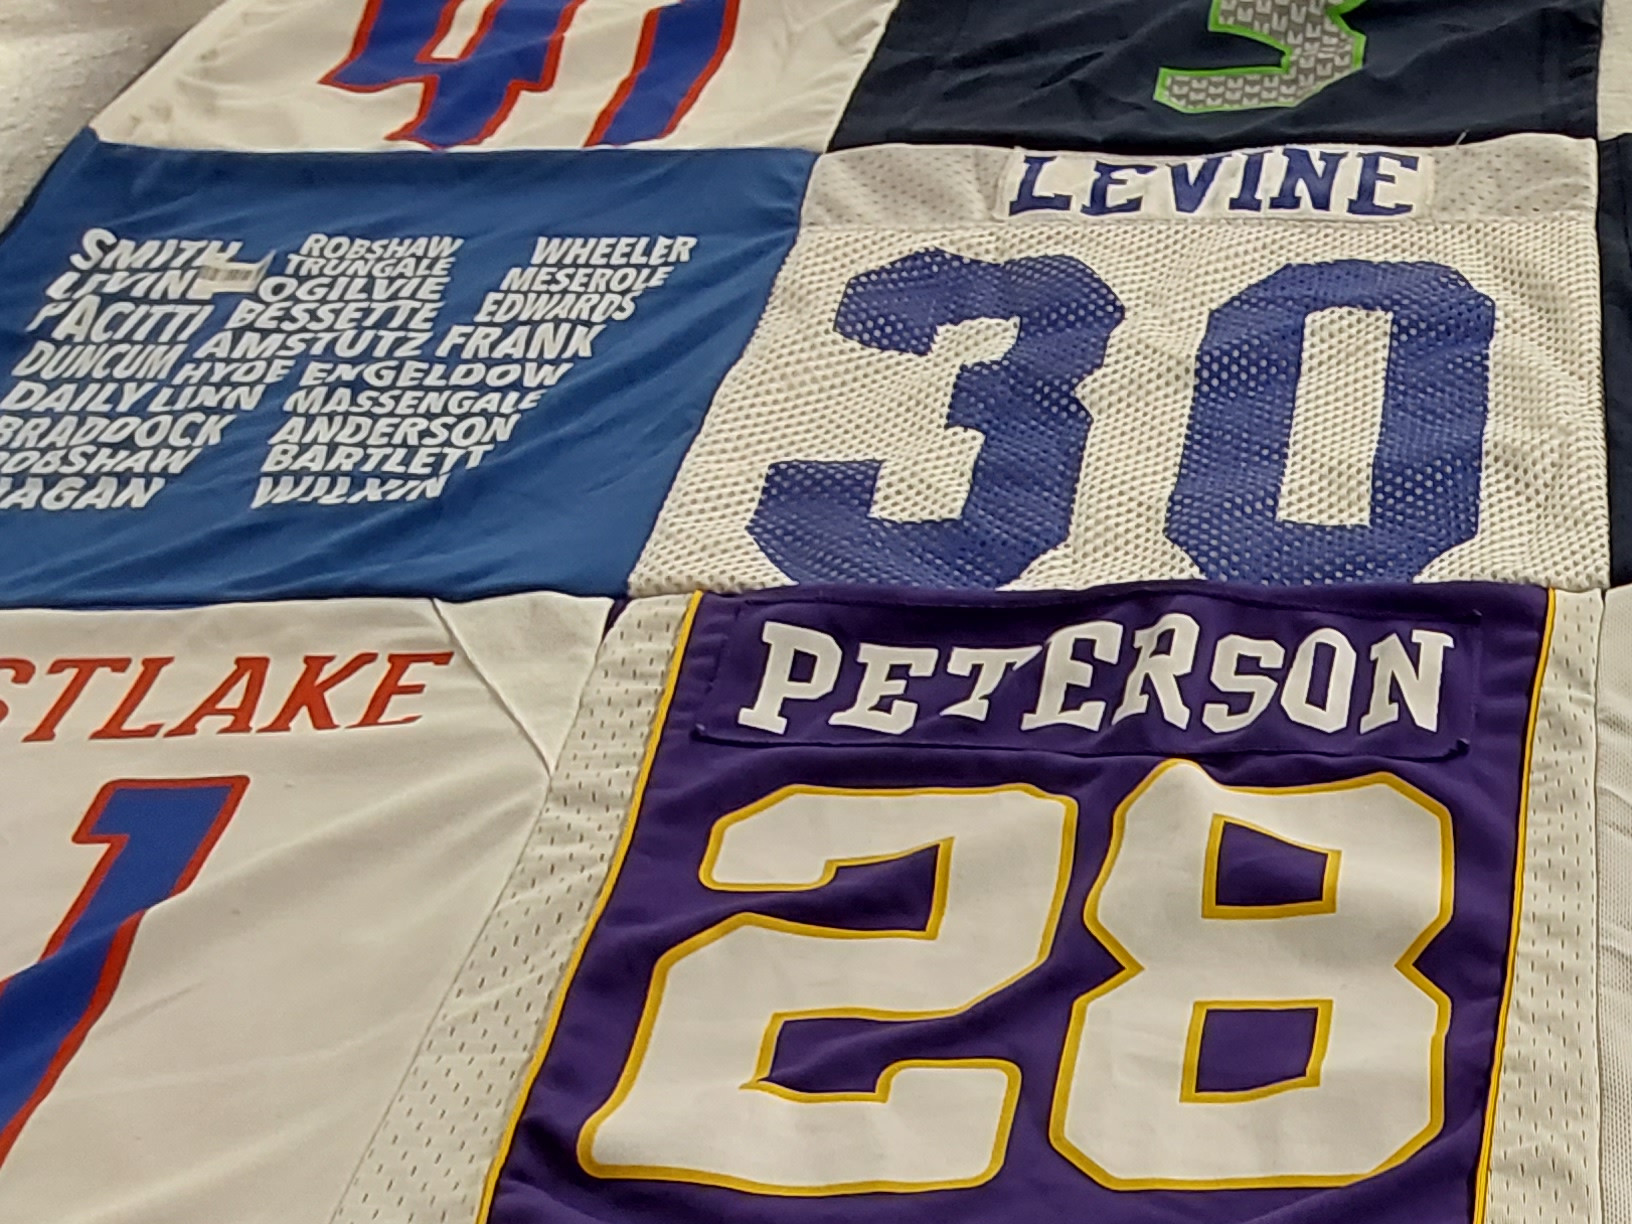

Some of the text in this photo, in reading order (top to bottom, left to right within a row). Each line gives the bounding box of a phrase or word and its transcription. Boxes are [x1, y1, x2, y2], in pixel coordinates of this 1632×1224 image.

[319, 0, 740, 149] 41
[1008, 148, 1423, 217] LEVINE
[70, 228, 243, 271] SMITH
[300, 233, 464, 258] ROBSHAW
[531, 236, 697, 265] WHEELER
[285, 253, 456, 277] TRUNGALE
[500, 266, 674, 292] MESEROLE
[259, 275, 450, 302] OGILVIE
[225, 300, 445, 330] BESSETTE
[473, 290, 643, 322] EDWARDS
[193, 329, 433, 358] AMSTUTZ
[435, 322, 607, 359] FRANK
[11, 341, 188, 380] DUNCUM
[171, 359, 295, 386] HYDE
[299, 359, 573, 387] ENGELDOW
[0, 380, 158, 412] DAILY
[147, 384, 266, 411] LINN
[283, 386, 547, 414] MASSENGALE
[0, 414, 236, 448] BRADDOCK
[268, 413, 521, 446] ANDERSON
[746, 247, 1496, 590] 30
[260, 443, 494, 474] BARTLETT
[737, 613, 1454, 734] PETERSON
[577, 759, 1453, 1195] 28
